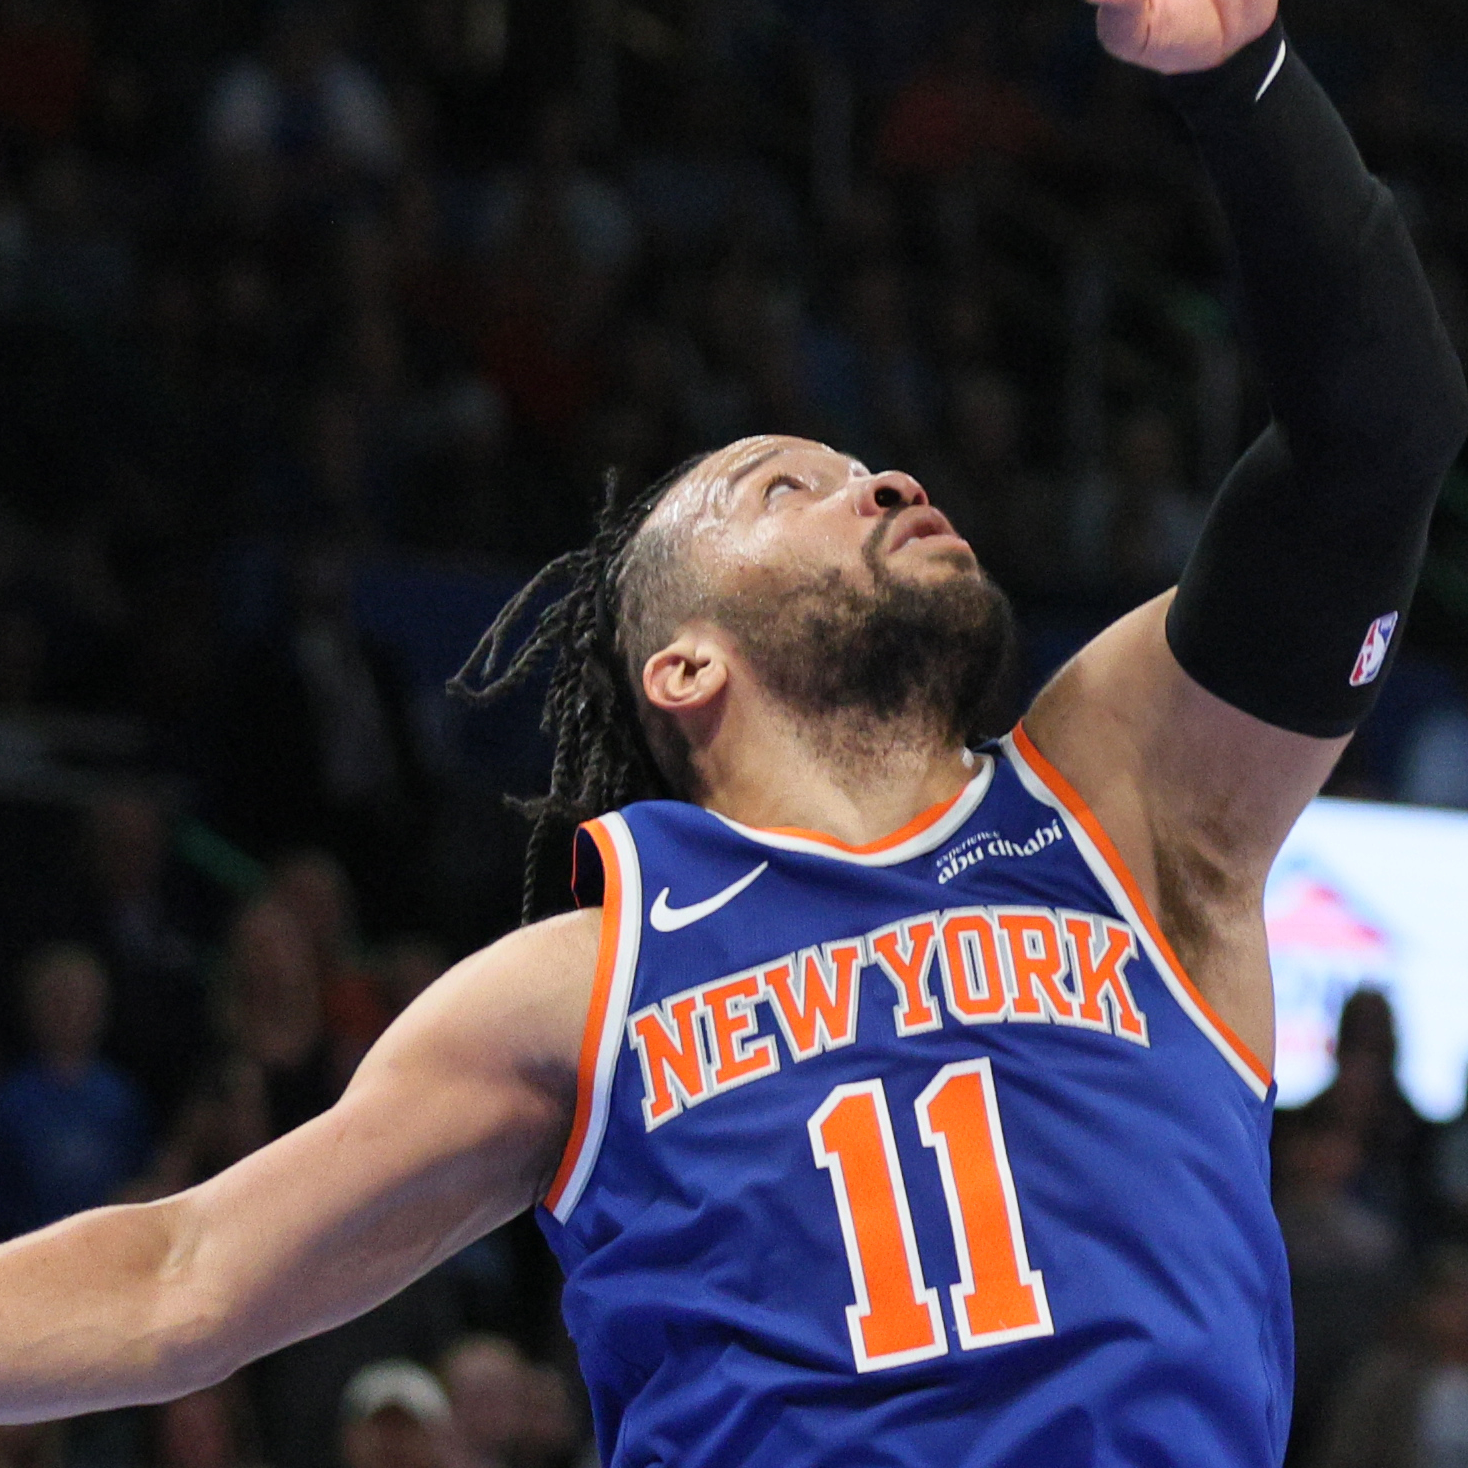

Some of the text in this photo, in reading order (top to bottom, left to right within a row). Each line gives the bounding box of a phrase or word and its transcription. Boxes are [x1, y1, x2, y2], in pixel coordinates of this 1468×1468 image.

[938, 818, 1063, 884] abu dhabi
[630, 905, 1150, 1132] NEW YORK
[807, 1057, 1054, 1374] 11
